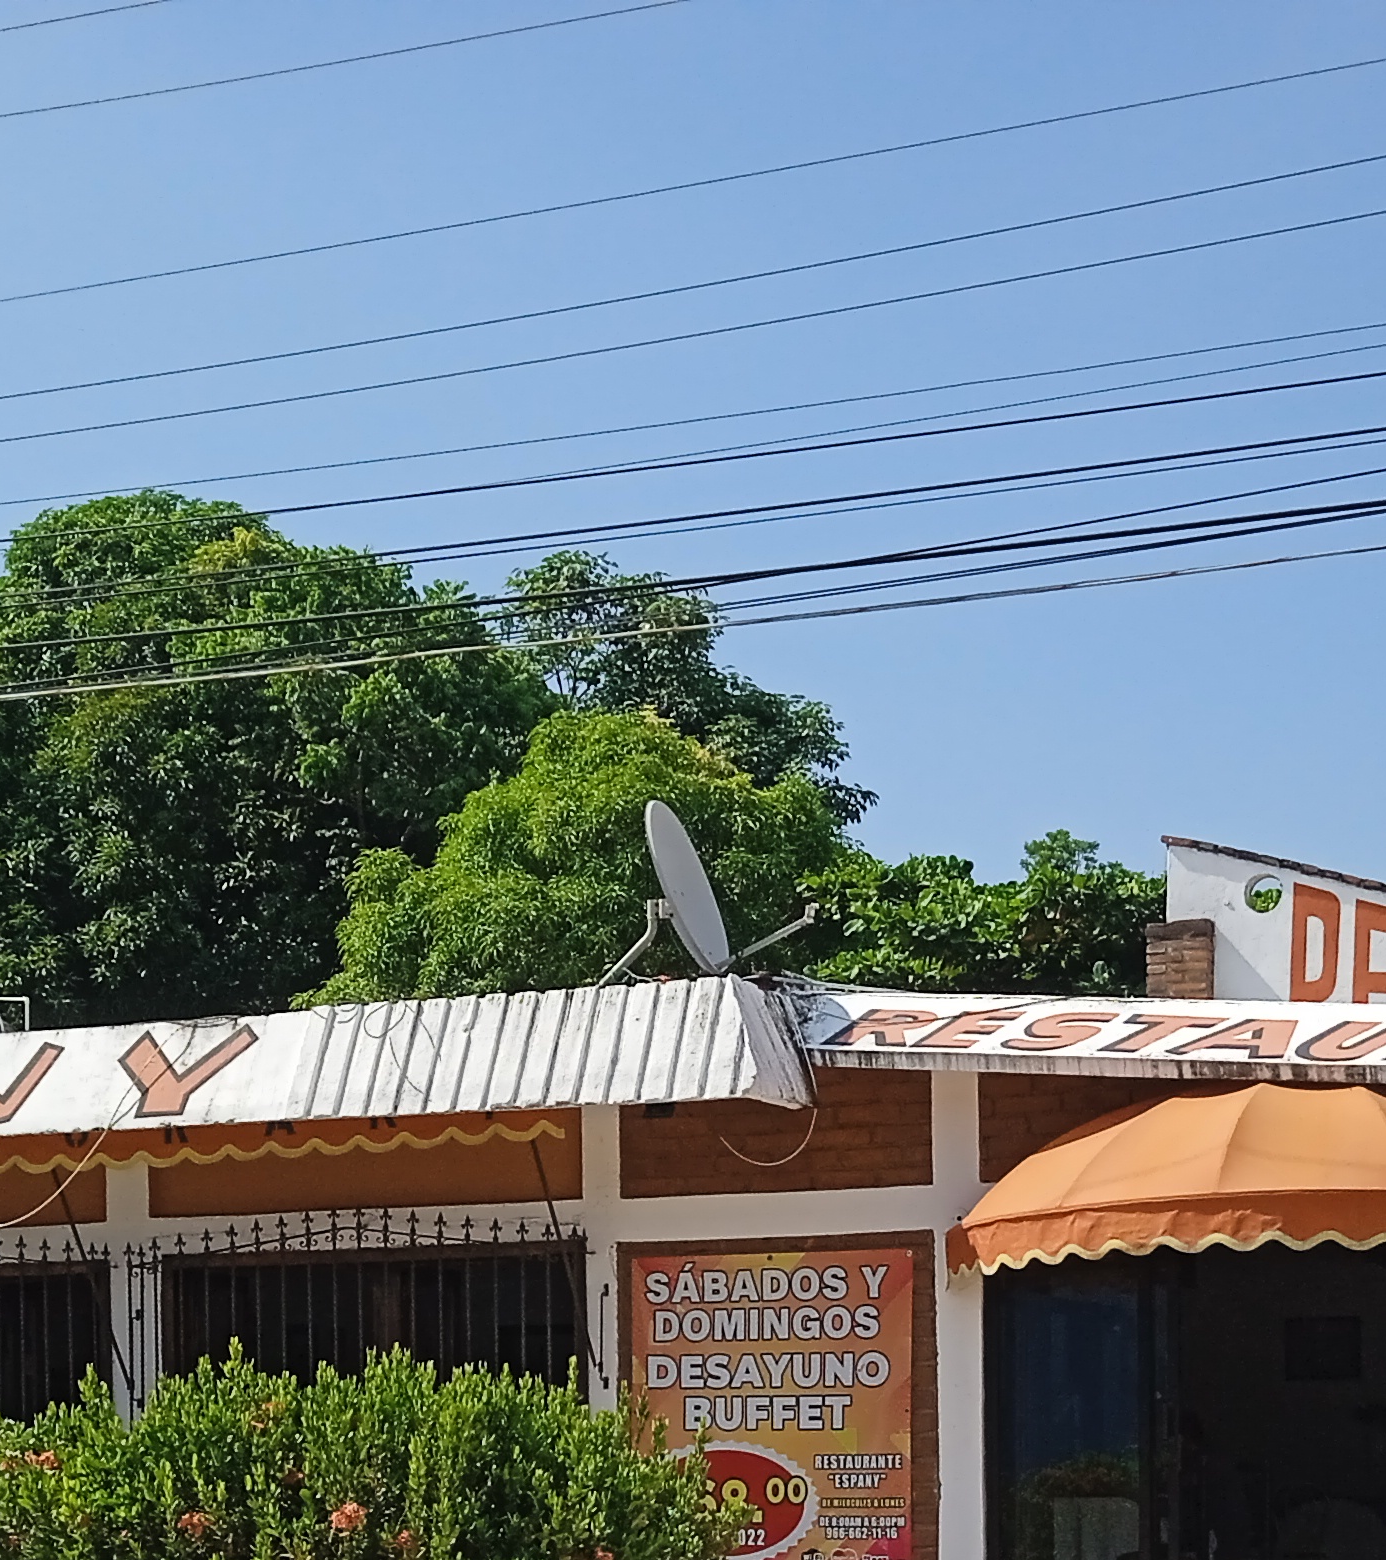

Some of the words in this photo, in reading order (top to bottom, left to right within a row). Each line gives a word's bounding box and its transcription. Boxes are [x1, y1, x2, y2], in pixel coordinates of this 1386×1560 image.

[645, 1262, 848, 1304] SÁBADOS
[861, 1265, 889, 1299] Y
[653, 1304, 880, 1343] DOMINGOS
[646, 1350, 891, 1389] DESAYUNO
[683, 1394, 853, 1431] BUFFET
[814, 1454, 902, 1470] RESTAURANTE
[819, 1516, 830, 1527] DE
[826, 1527, 898, 1540] 966-662-11-16
